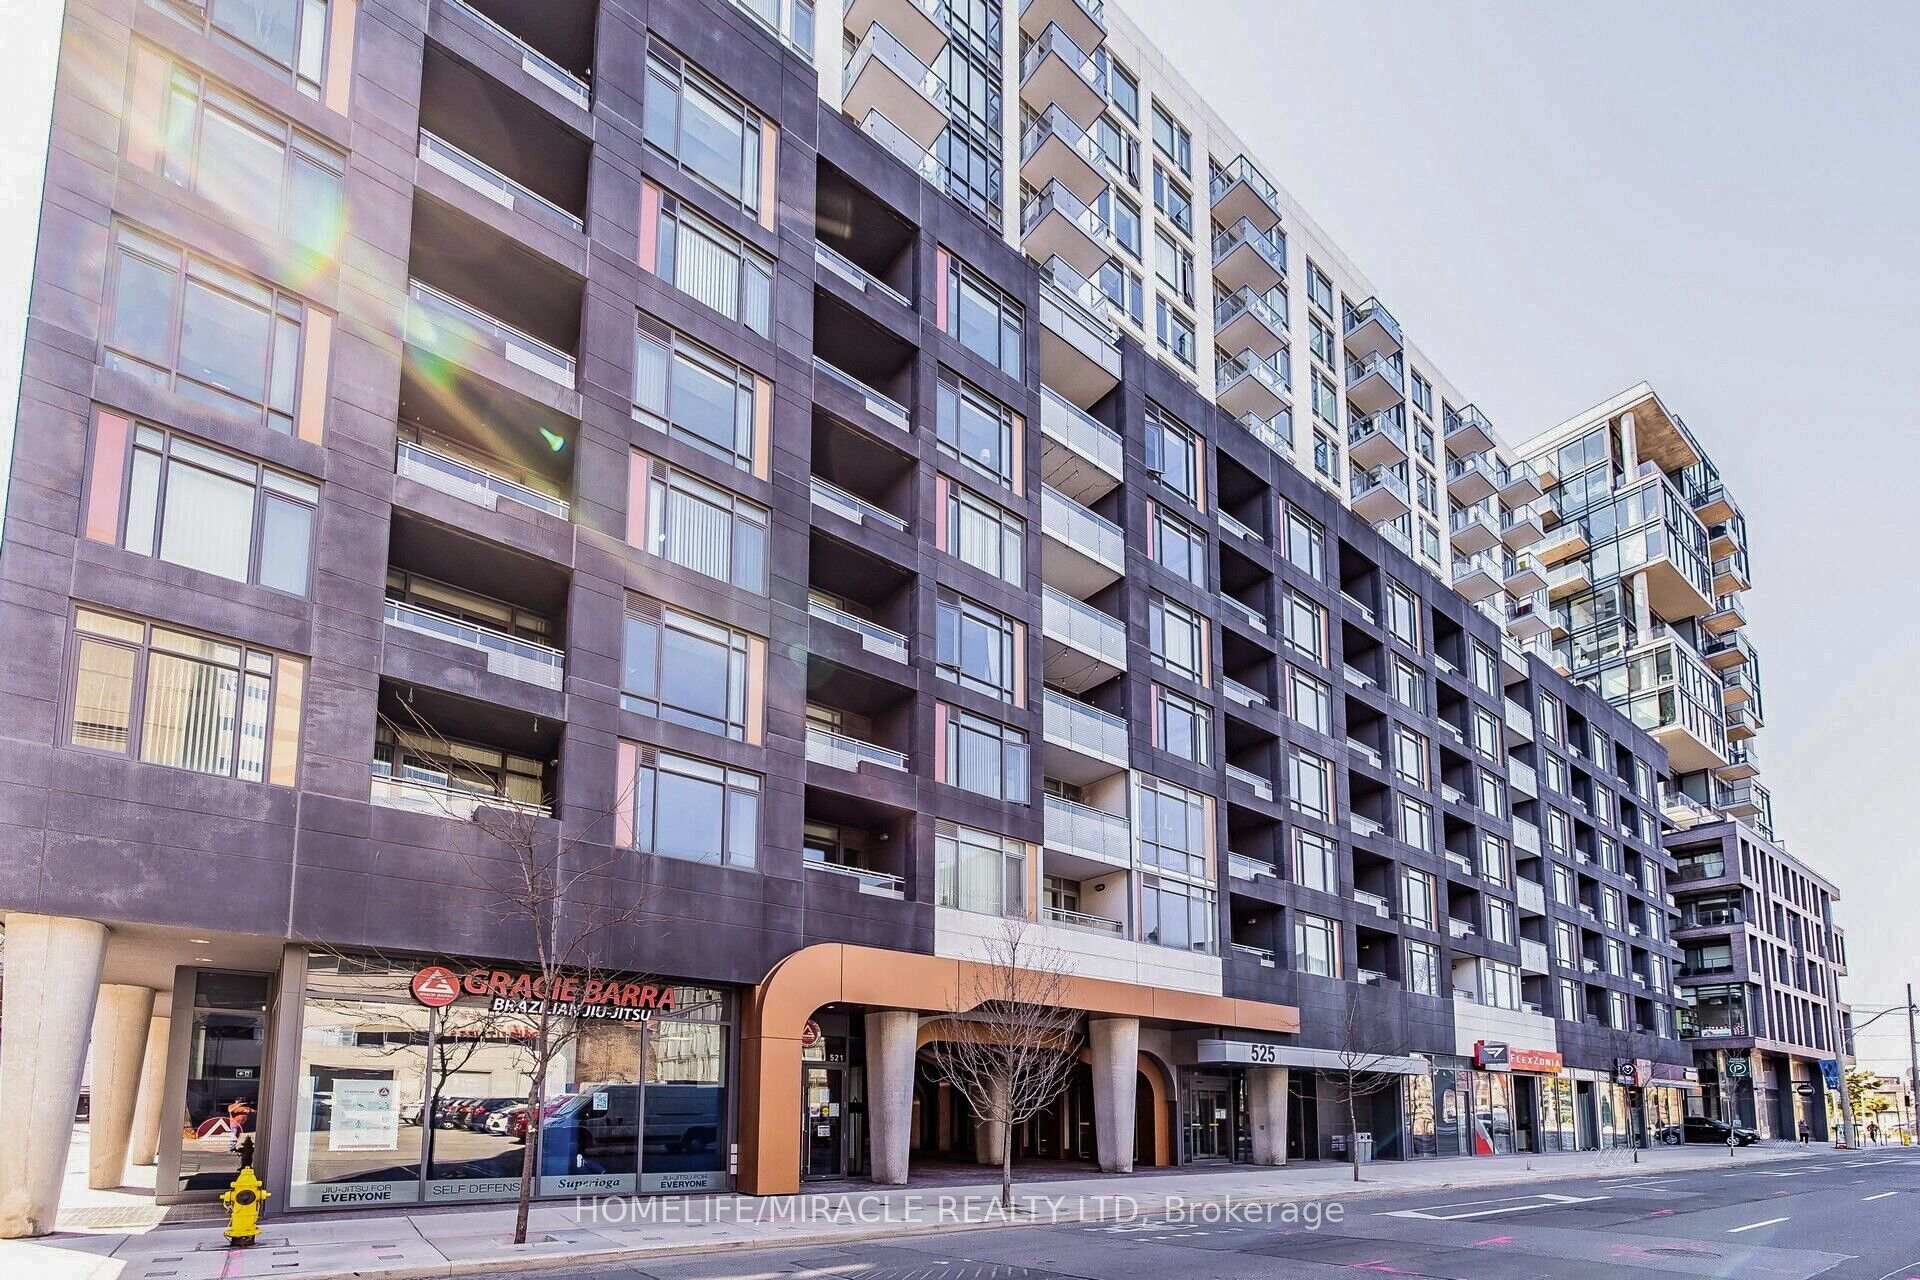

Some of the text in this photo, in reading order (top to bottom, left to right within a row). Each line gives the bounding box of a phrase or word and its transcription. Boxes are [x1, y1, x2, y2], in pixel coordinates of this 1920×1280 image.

[464, 968, 676, 1009] GRACIE BARRA
[583, 1005, 651, 1021] JIU-JITSU
[829, 1054, 844, 1062] 521
[1251, 1045, 1275, 1062] 525
[1510, 1054, 1560, 1067] FLEXZONIA
[322, 1184, 392, 1193] JIU-JITSU FOR
[433, 1182, 520, 1195] SELF DEFENS
[660, 1180, 707, 1189] EVERYONE
[321, 1191, 391, 1203] EVERYONE
